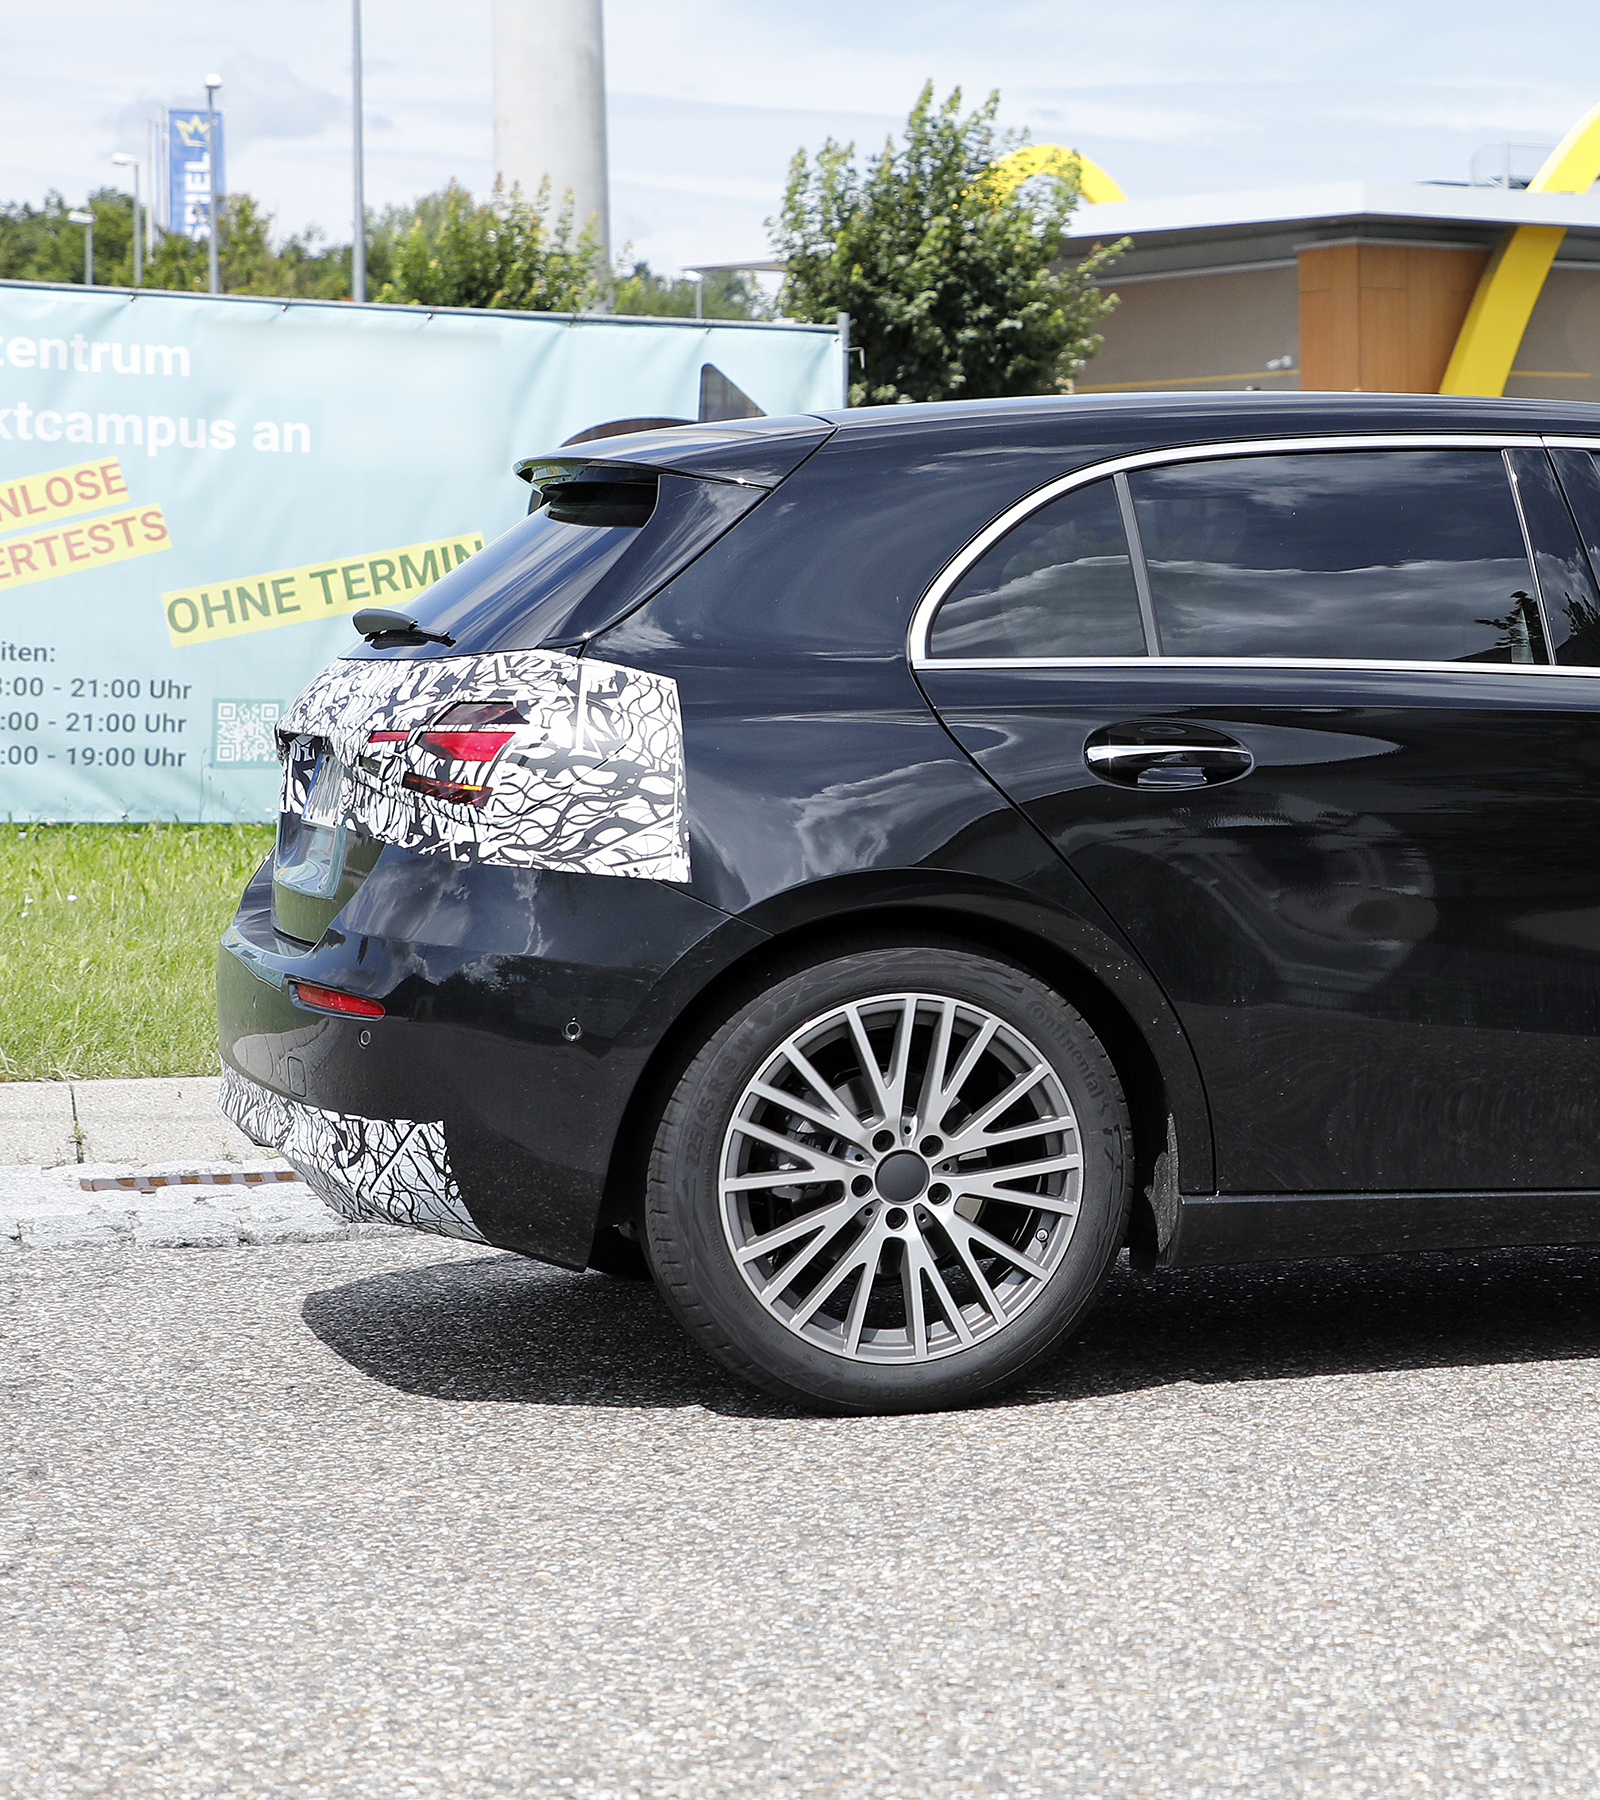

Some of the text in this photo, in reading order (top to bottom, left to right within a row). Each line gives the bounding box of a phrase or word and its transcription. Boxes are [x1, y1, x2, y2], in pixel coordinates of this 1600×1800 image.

[0, 333, 191, 377] entrum
[252, 420, 311, 453] an
[167, 577, 301, 633] OHNE
[71, 678, 141, 698] 21:00
[150, 679, 192, 699] Uhr
[66, 713, 136, 733] 21:00
[145, 713, 187, 732] Uhr
[66, 747, 135, 766] 19:00
[144, 748, 187, 767] Uhr
[1026, 999, 1106, 1099] Continental
[684, 1096, 716, 1168] 225/45
[707, 1078, 727, 1094] R
[719, 1055, 738, 1077] 18
